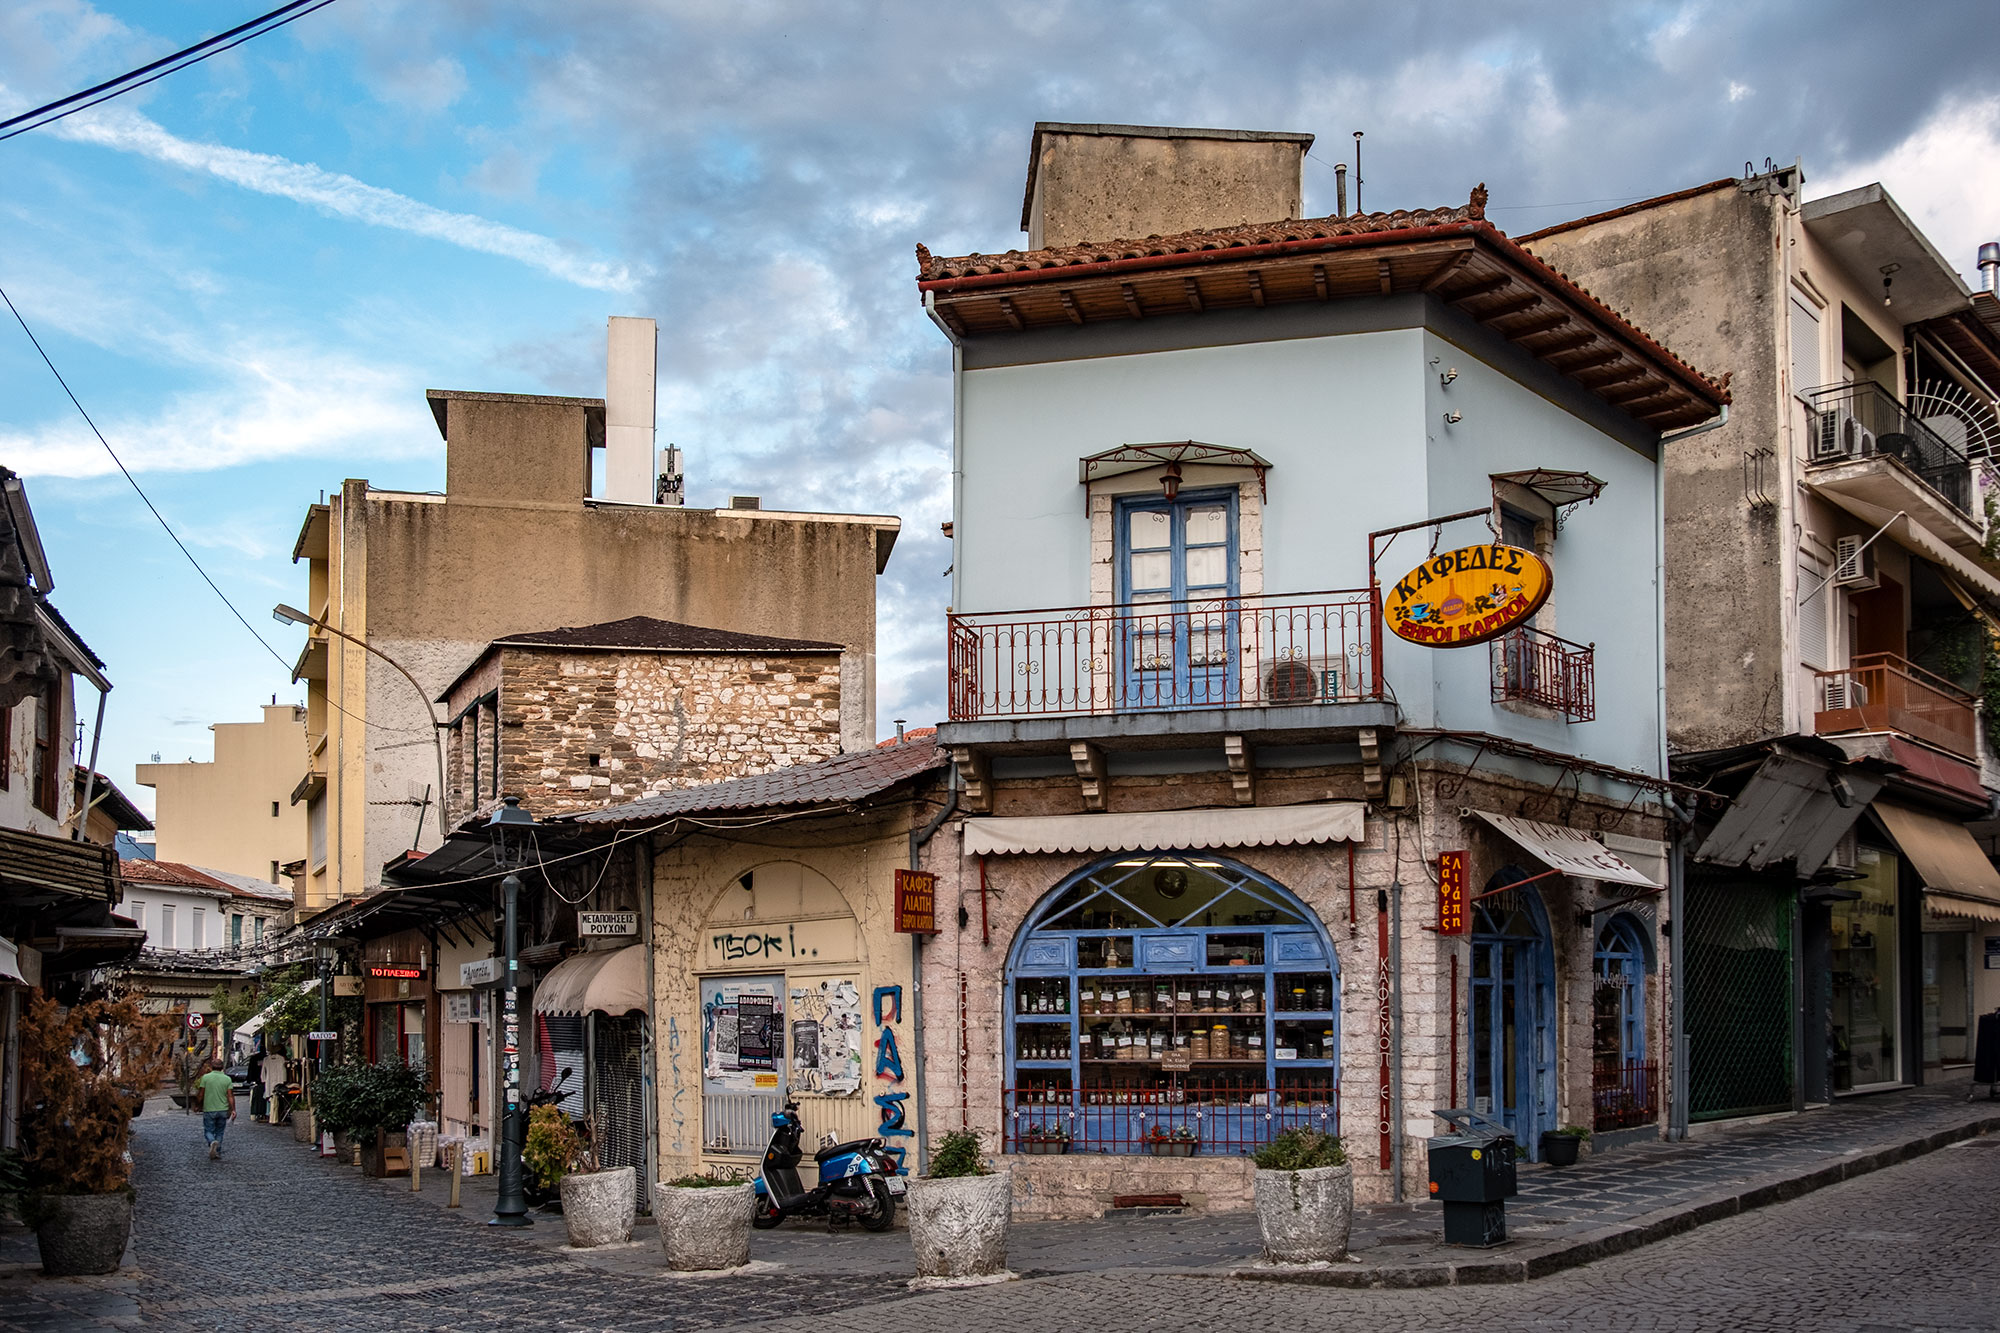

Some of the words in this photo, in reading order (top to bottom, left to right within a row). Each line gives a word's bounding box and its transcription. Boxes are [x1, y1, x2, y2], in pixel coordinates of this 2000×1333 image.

[1394, 546, 1524, 604] ΚΑΦΕΔΕΣ
[1398, 619, 1453, 643] ΞΗΡΟΙ
[1458, 593, 1530, 641] ΚΑΡΠΟΙ
[902, 874, 933, 893] ΚΑΦΕΣ
[1441, 855, 1451, 931] καφές
[1452, 857, 1462, 928] Λιάπη
[903, 895, 932, 912] ΛΙΑΠΗ
[582, 914, 635, 924] ΜΕΤΑΠΟΙΗΣΕΙΣ
[591, 924, 627, 933] ΡΟΥΧΩΝ
[371, 968, 382, 977] ΤΟ
